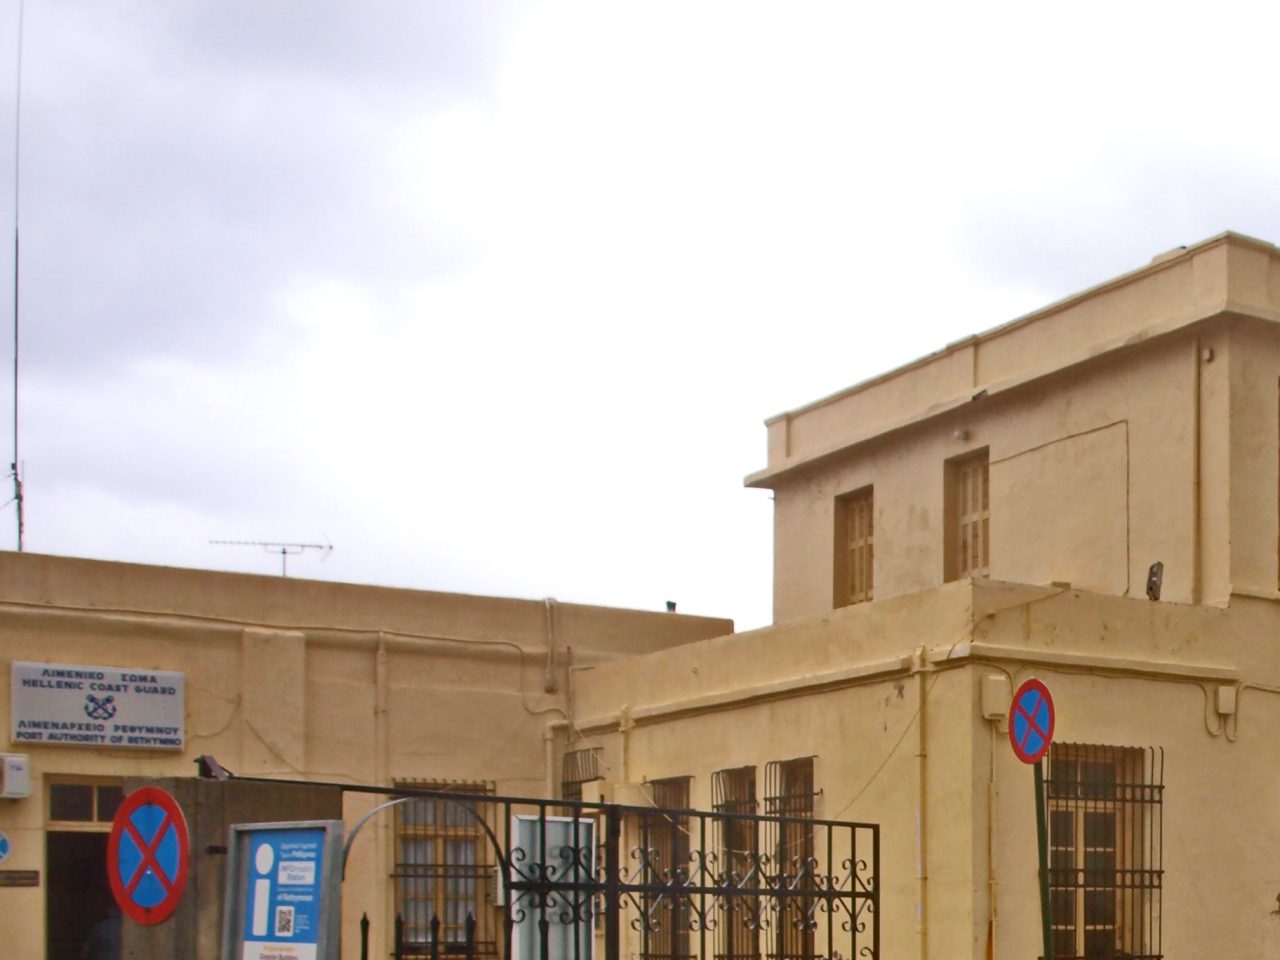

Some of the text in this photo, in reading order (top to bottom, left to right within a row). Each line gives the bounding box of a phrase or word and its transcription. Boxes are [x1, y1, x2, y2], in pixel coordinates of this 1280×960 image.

[41, 668, 157, 683] ΛΙΜΕΝΙΚΟ ΣΩΜΑ
[22, 679, 176, 695] HELLENIC COAST GUARD
[18, 720, 179, 735] ΛΙΜΕΝΑΡΧΕΙΟ ΡΕΘΥΜΝΟΥ
[16, 731, 43, 740] PORT
[48, 732, 106, 742] AUTHORITY
[110, 735, 123, 744] OF
